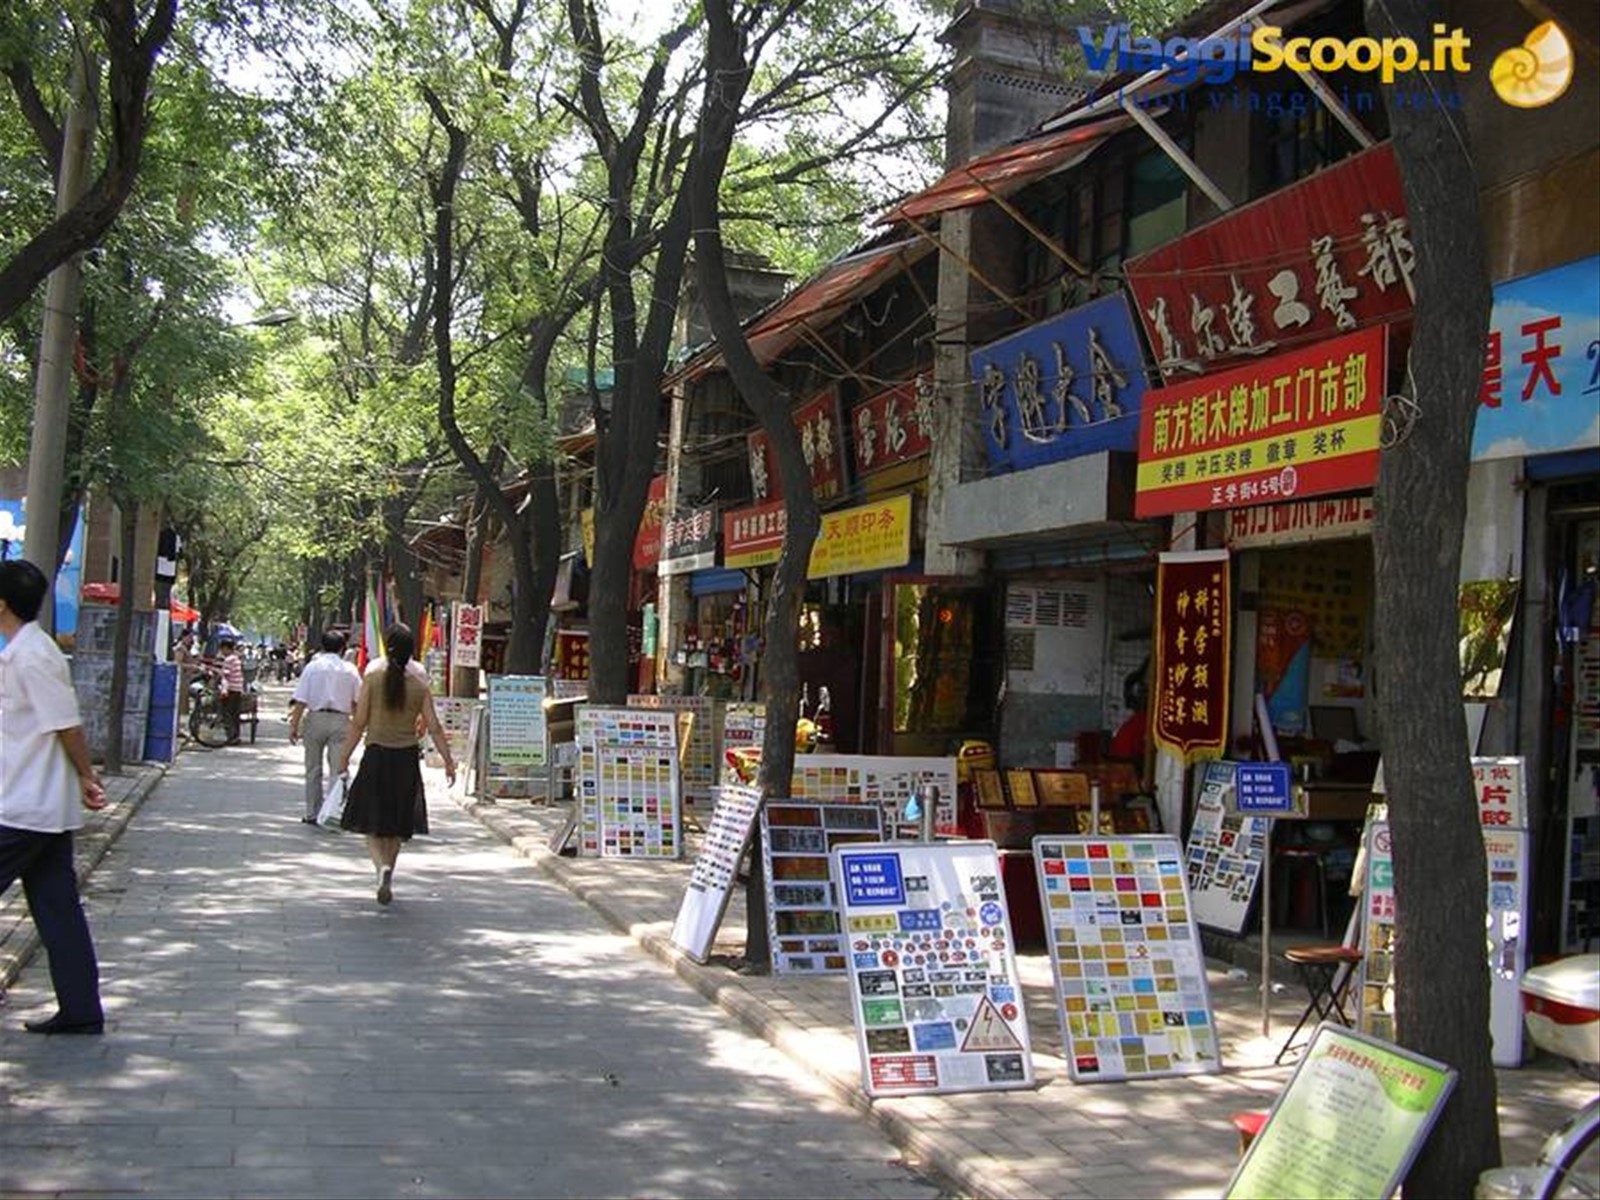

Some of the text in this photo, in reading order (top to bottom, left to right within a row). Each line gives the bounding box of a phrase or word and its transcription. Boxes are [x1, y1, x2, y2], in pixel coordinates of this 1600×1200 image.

[1152, 353, 1367, 453] 南方铜木牌加工门市部
[1313, 428, 1346, 455] 奖杯
